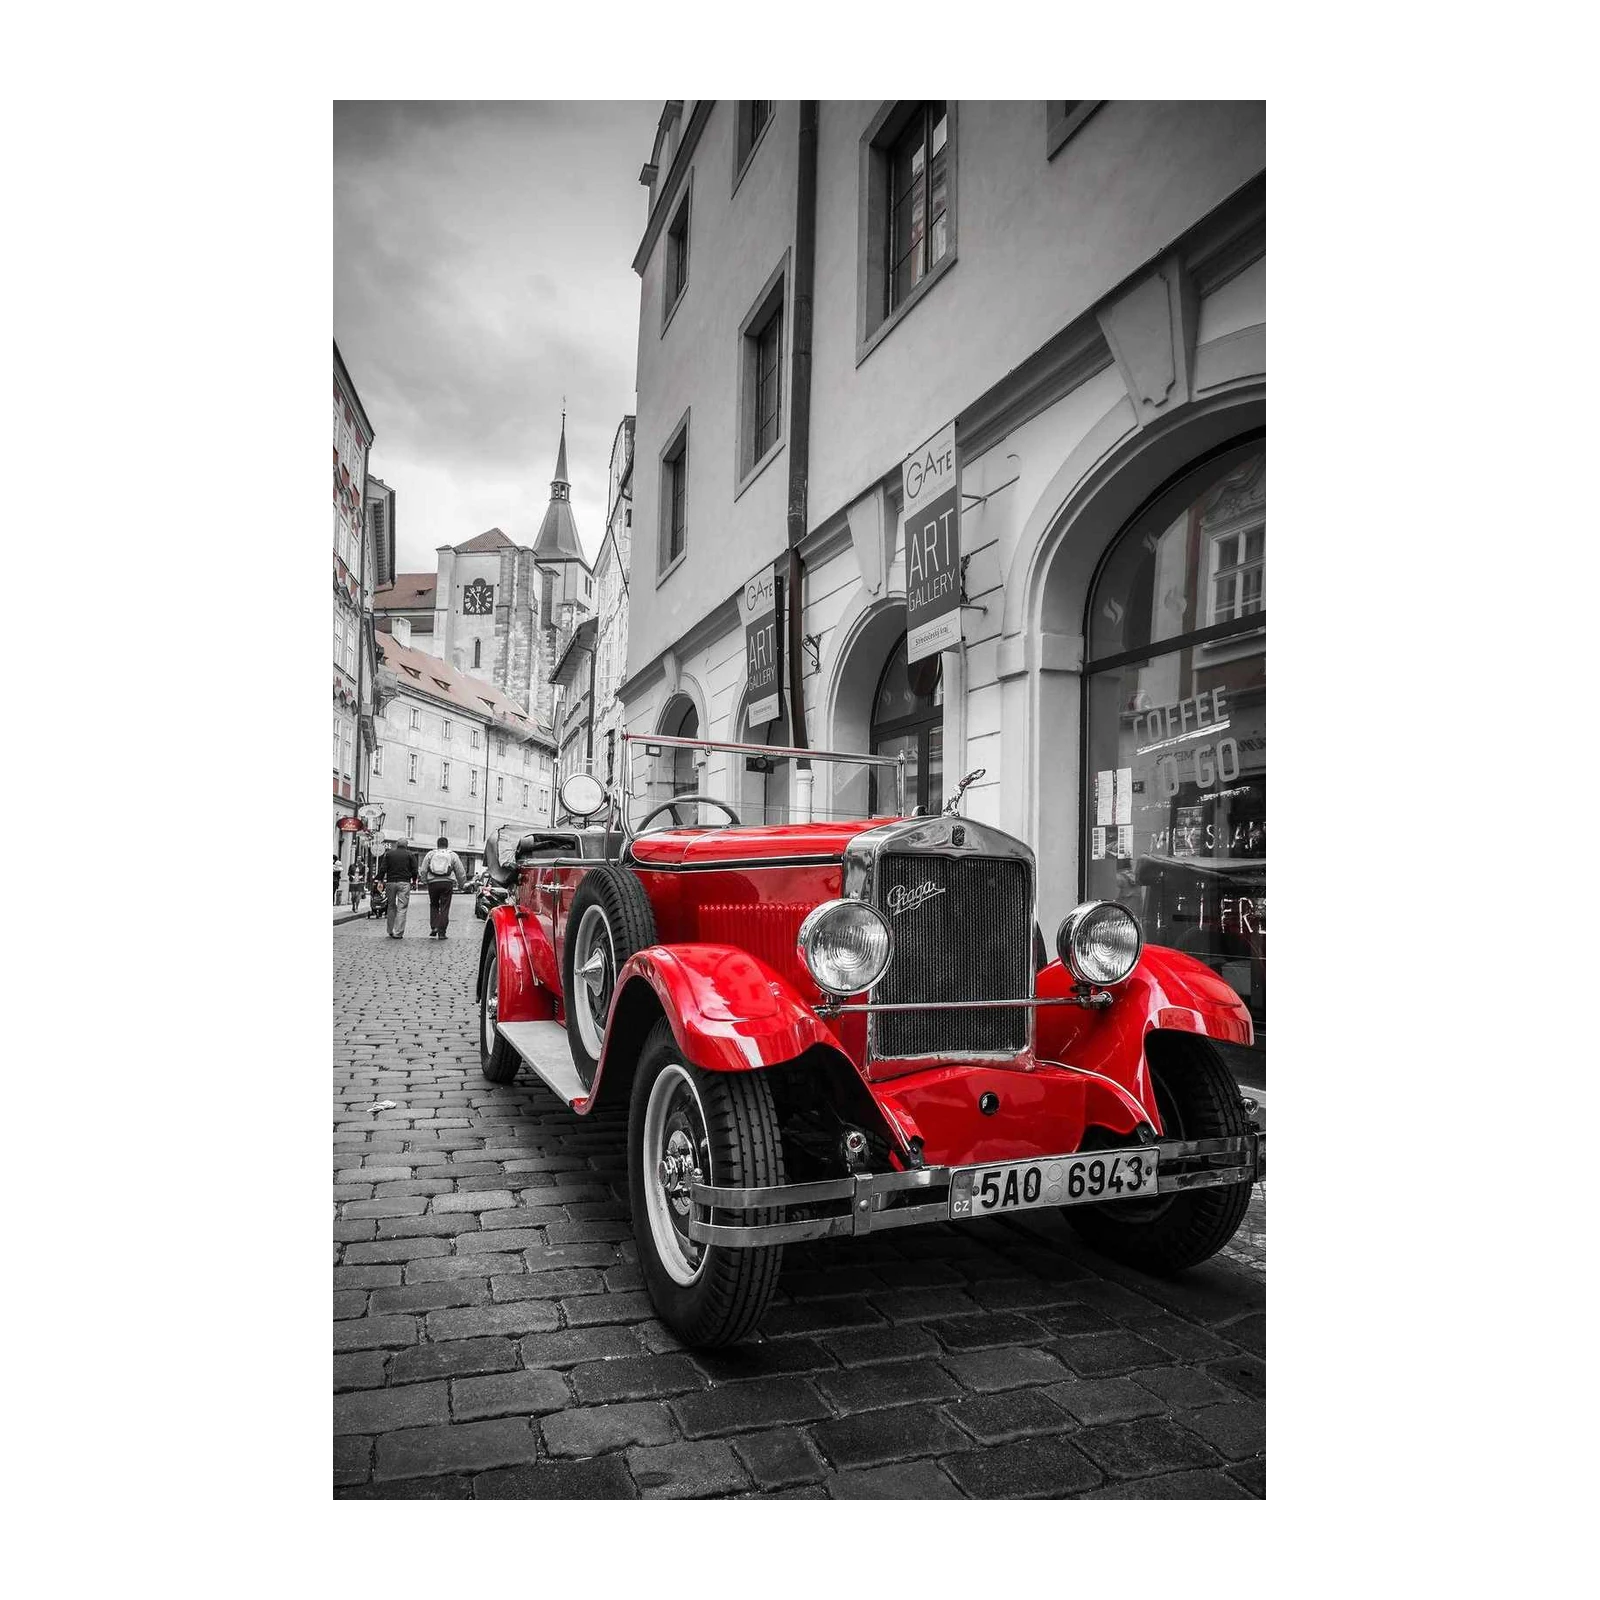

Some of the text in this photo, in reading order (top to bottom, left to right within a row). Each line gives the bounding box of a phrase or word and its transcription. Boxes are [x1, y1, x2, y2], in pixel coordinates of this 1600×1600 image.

[906, 449, 952, 499] GATE
[908, 508, 954, 588] ART
[746, 580, 773, 611] GATE
[908, 568, 956, 612] GALLERY
[748, 623, 774, 674] ART
[1194, 738, 1240, 789] GO
[887, 880, 946, 916] Praga
[953, 1200, 970, 1213] CZ
[980, 1156, 1143, 1209] 5A0 6943
